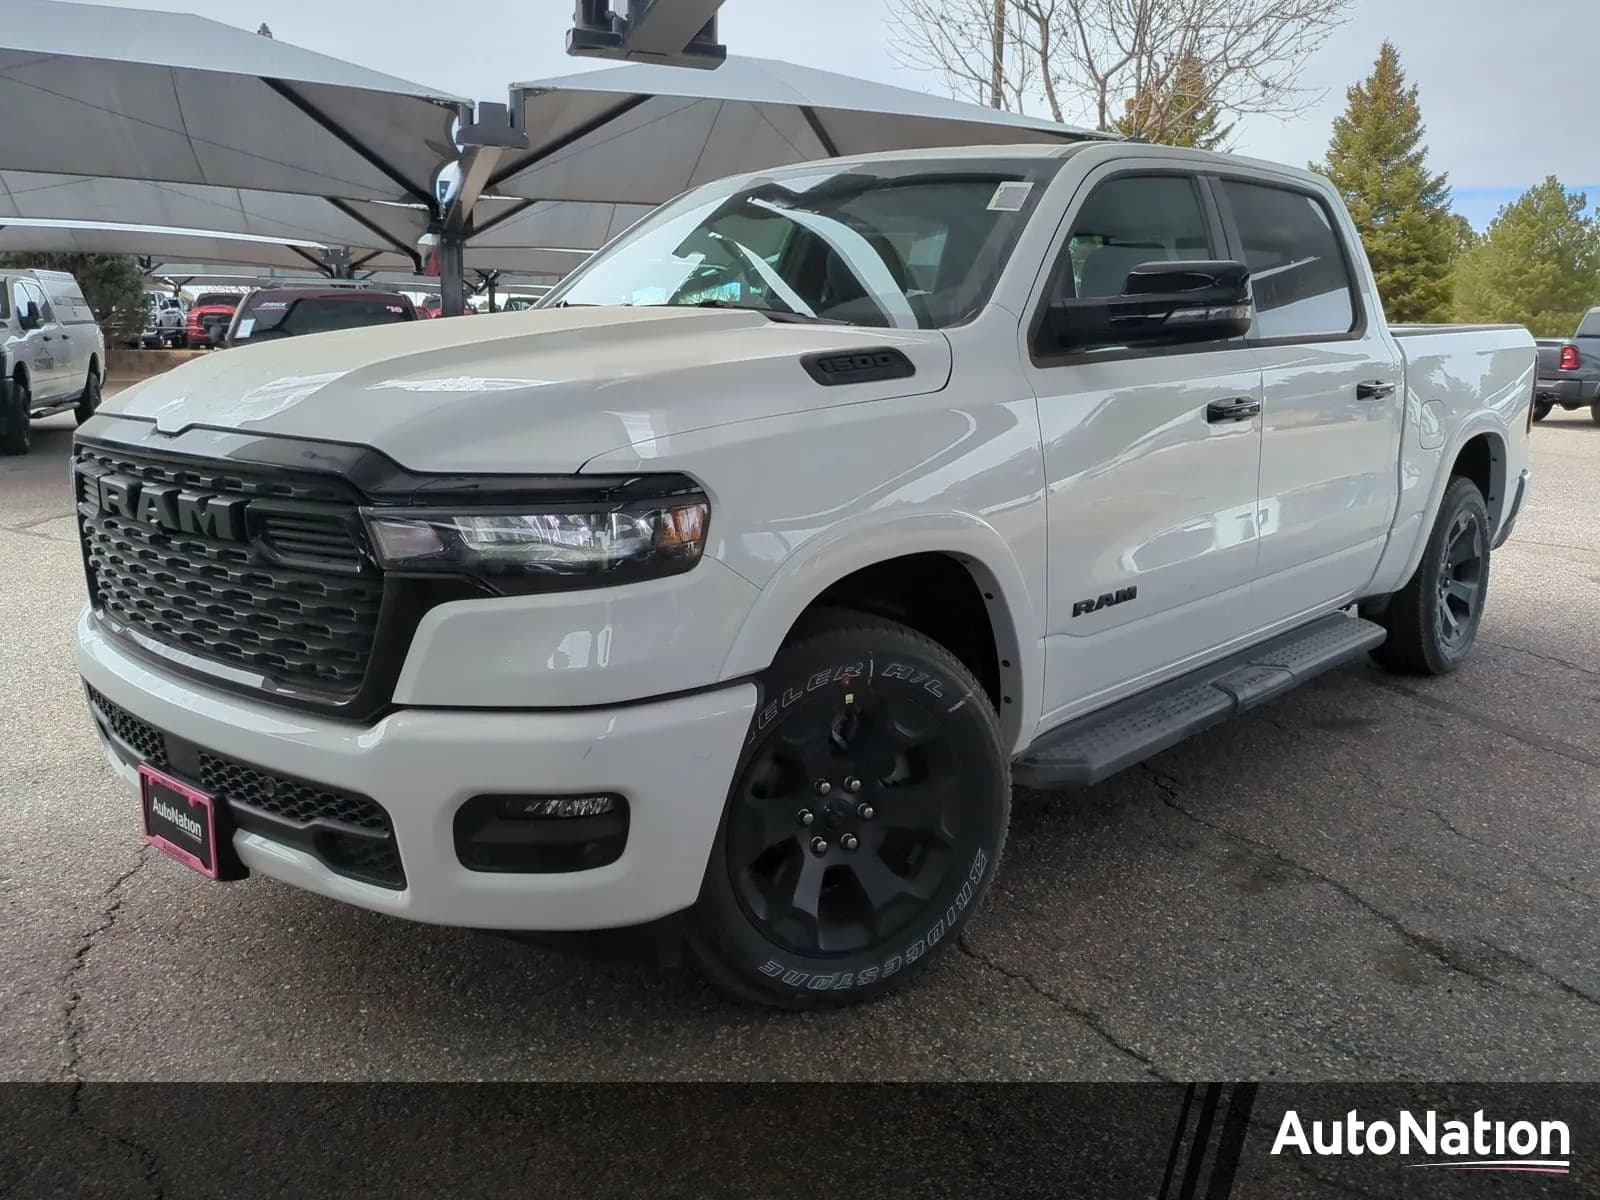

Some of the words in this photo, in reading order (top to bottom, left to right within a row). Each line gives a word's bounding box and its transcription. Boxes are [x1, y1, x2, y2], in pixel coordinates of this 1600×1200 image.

[817, 352, 899, 374] 1500
[99, 474, 250, 541] RAM
[1071, 585, 1137, 618] RAM
[152, 796, 202, 838] AutoNation
[758, 847, 988, 991] BRIDGESTONE
